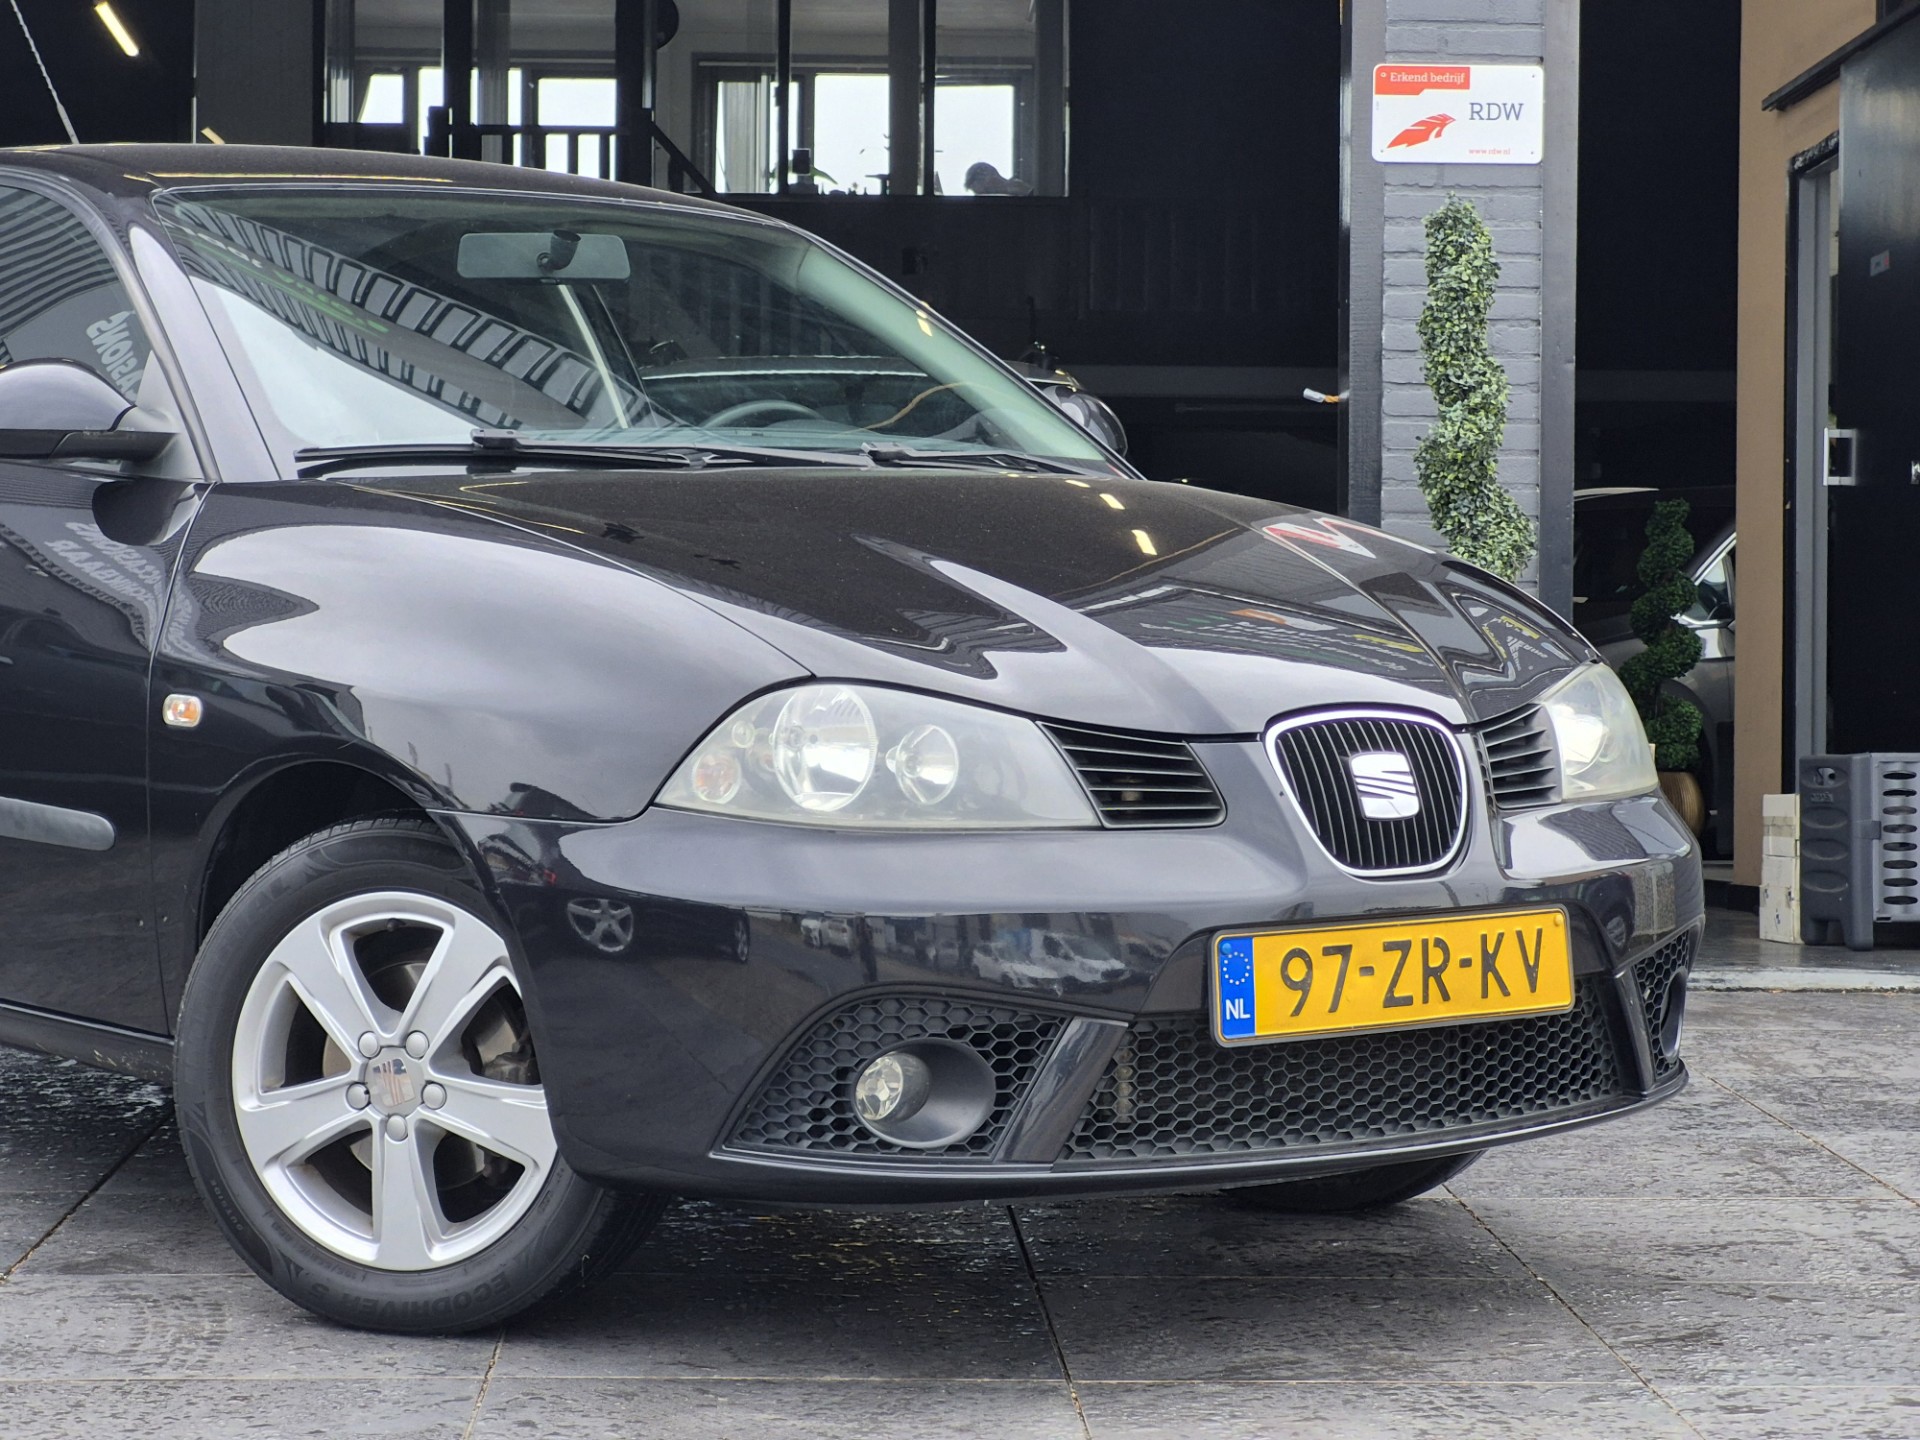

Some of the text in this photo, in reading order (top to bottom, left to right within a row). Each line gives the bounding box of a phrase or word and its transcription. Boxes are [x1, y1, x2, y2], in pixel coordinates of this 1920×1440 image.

[1390, 72, 1465, 85] Erkend bedrijf
[1469, 102, 1524, 121] RDW
[1280, 928, 1543, 1017] 97-ZR-KV
[1225, 998, 1250, 1020] NL
